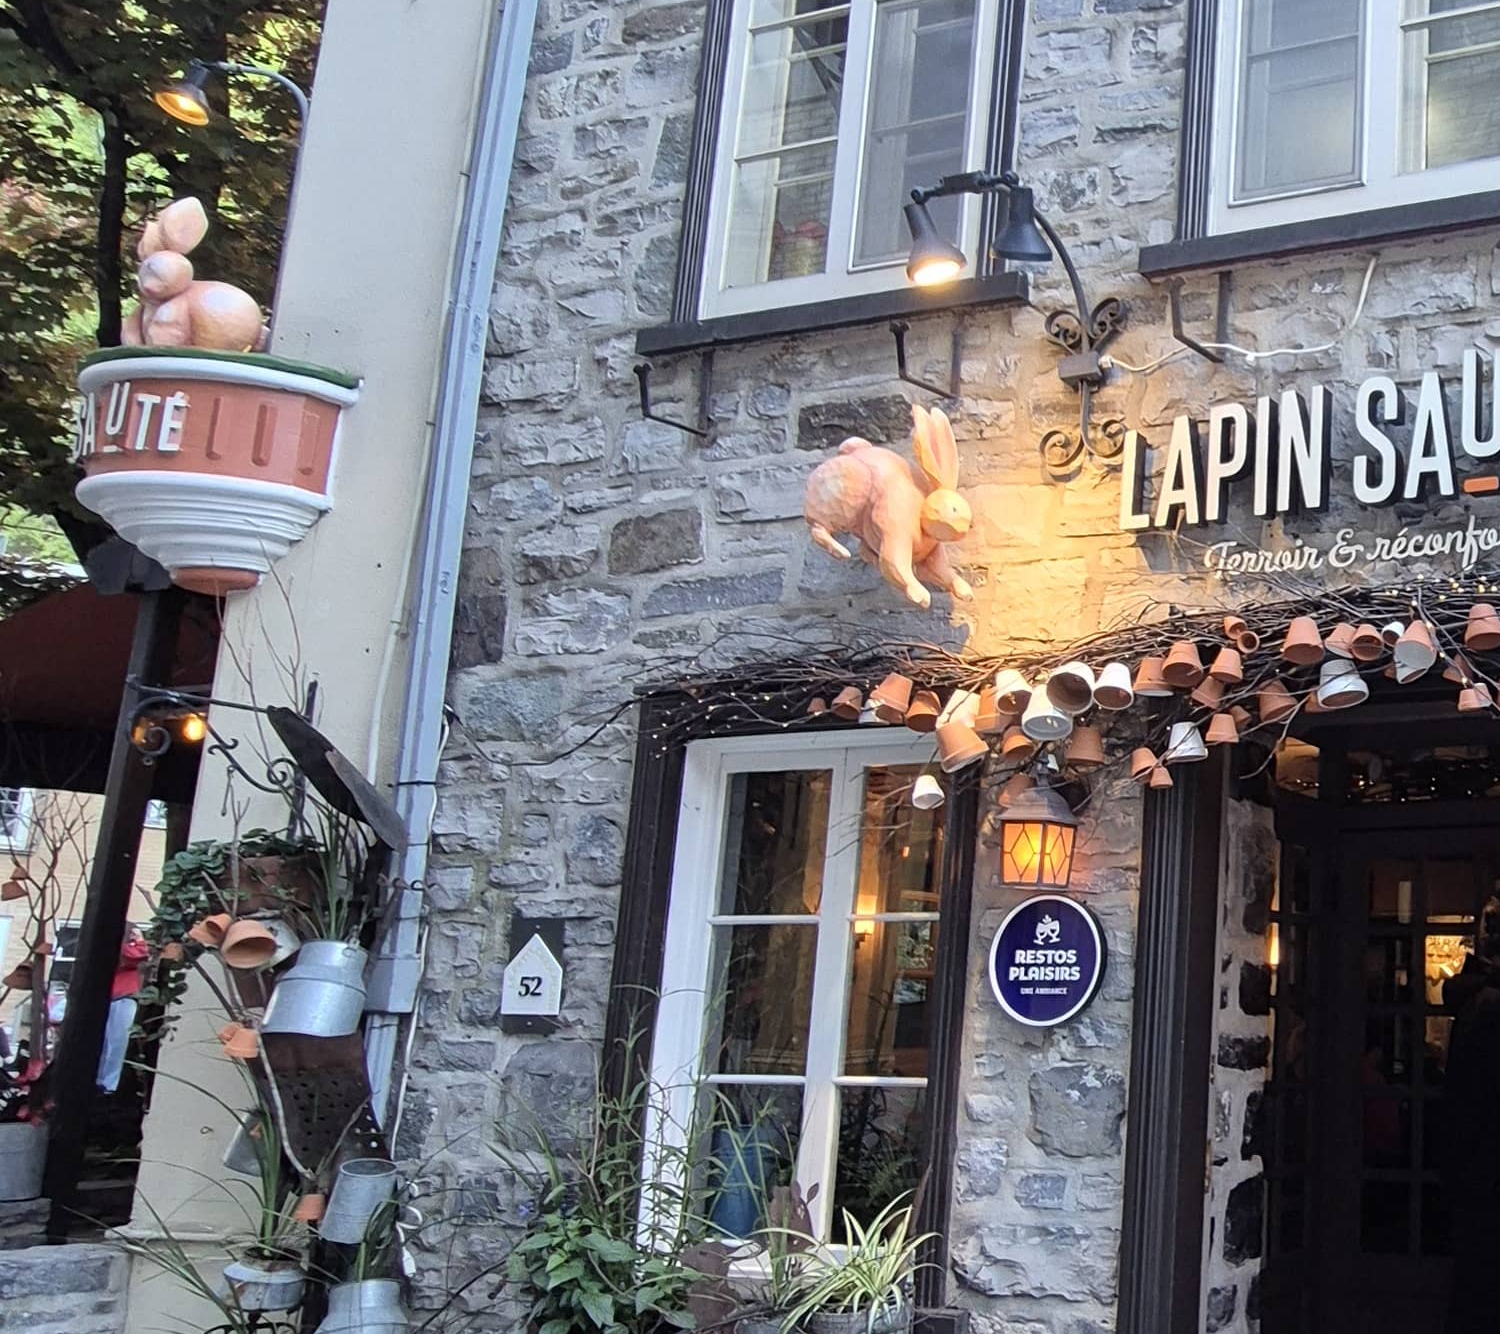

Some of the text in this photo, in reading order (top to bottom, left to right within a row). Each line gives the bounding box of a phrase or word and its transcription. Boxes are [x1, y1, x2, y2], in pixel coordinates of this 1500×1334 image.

[1119, 384, 1331, 531] LAPIN
[1204, 539, 1324, 579] Terroir
[1328, 528, 1364, 568] &
[1015, 950, 1077, 965] RESTOS
[1008, 966, 1081, 981] PLAISIRS
[518, 976, 542, 997] 52
